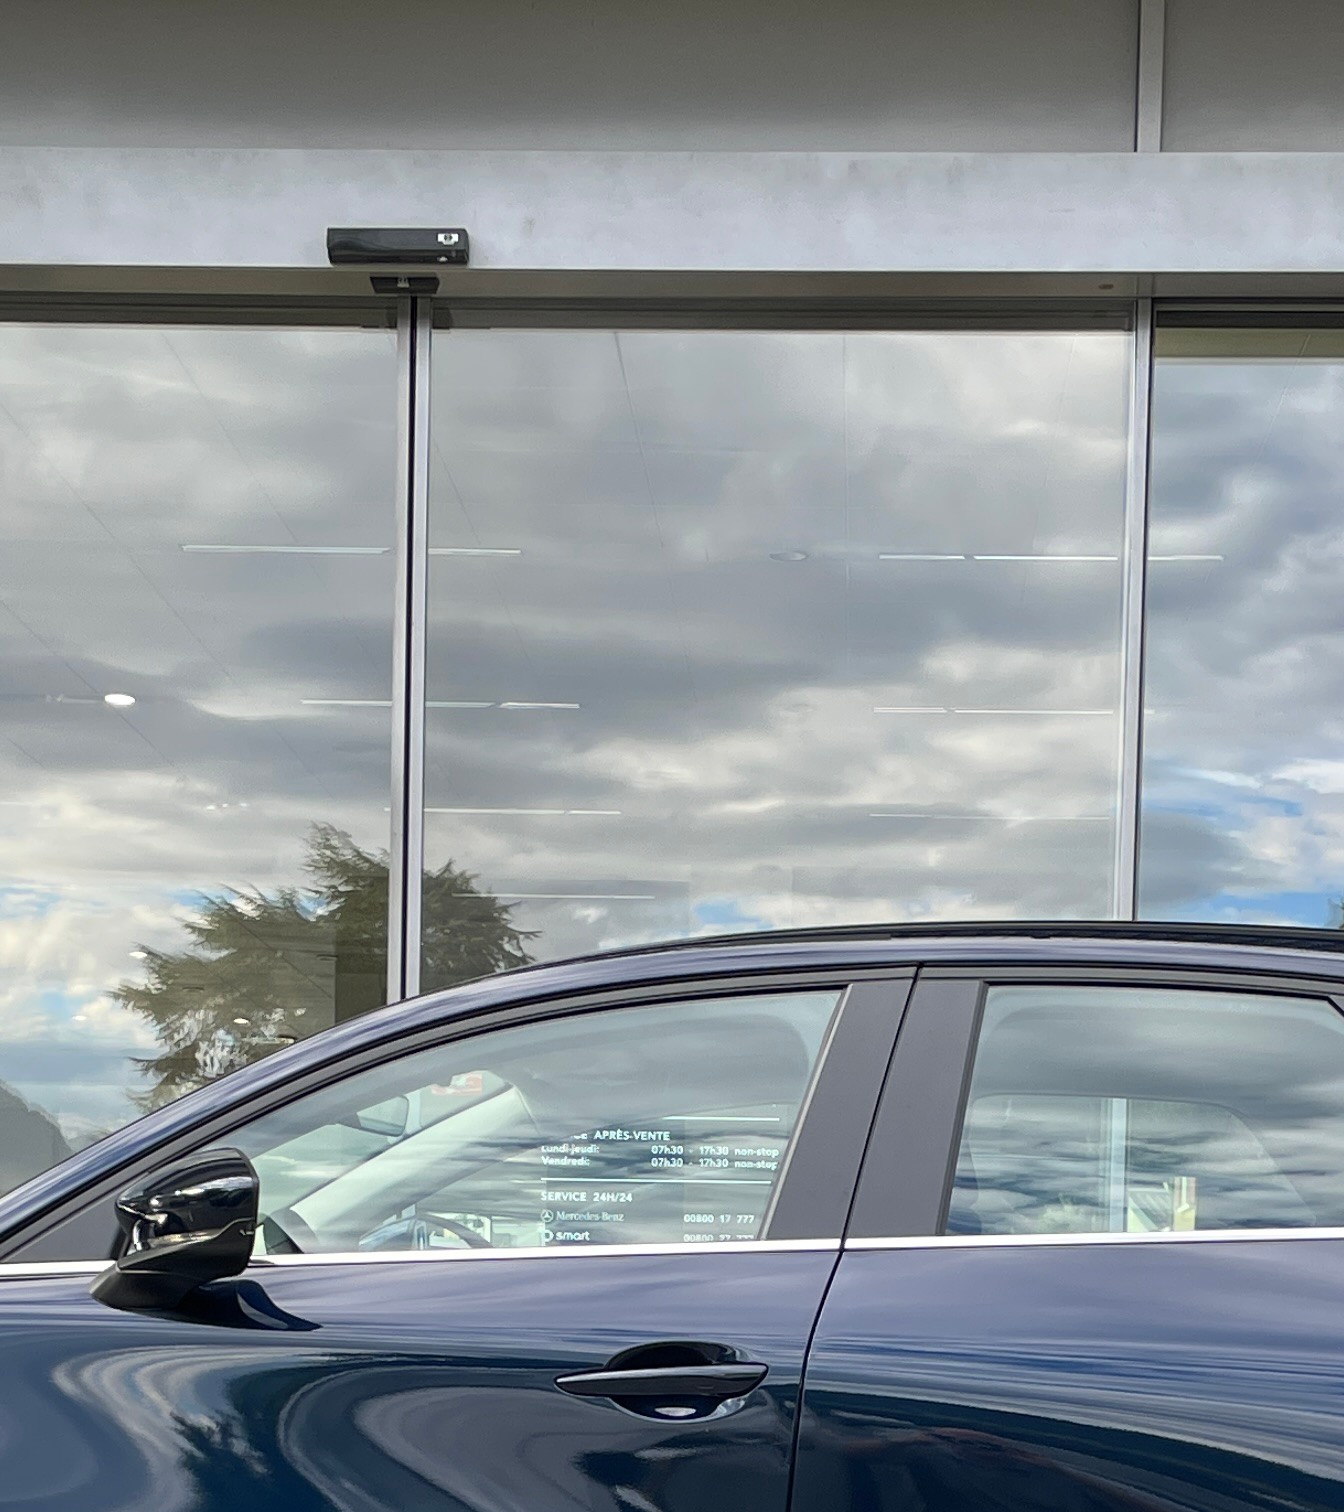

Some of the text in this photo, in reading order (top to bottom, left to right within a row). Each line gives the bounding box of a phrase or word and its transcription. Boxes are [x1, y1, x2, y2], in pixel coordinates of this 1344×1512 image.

[594, 1129, 670, 1141] APRÈS-VENTE
[651, 1145, 683, 1155] 07h30
[699, 1146, 729, 1156] 17h30
[734, 1147, 779, 1158] non-stop
[651, 1157, 683, 1168] 07h30
[699, 1158, 729, 1168] 17h30
[540, 1191, 633, 1203] SERVICE 24H/24
[683, 1214, 714, 1223] 00800
[720, 1214, 731, 1223] 17
[736, 1214, 755, 1224] 777
[556, 1231, 590, 1241] smart
